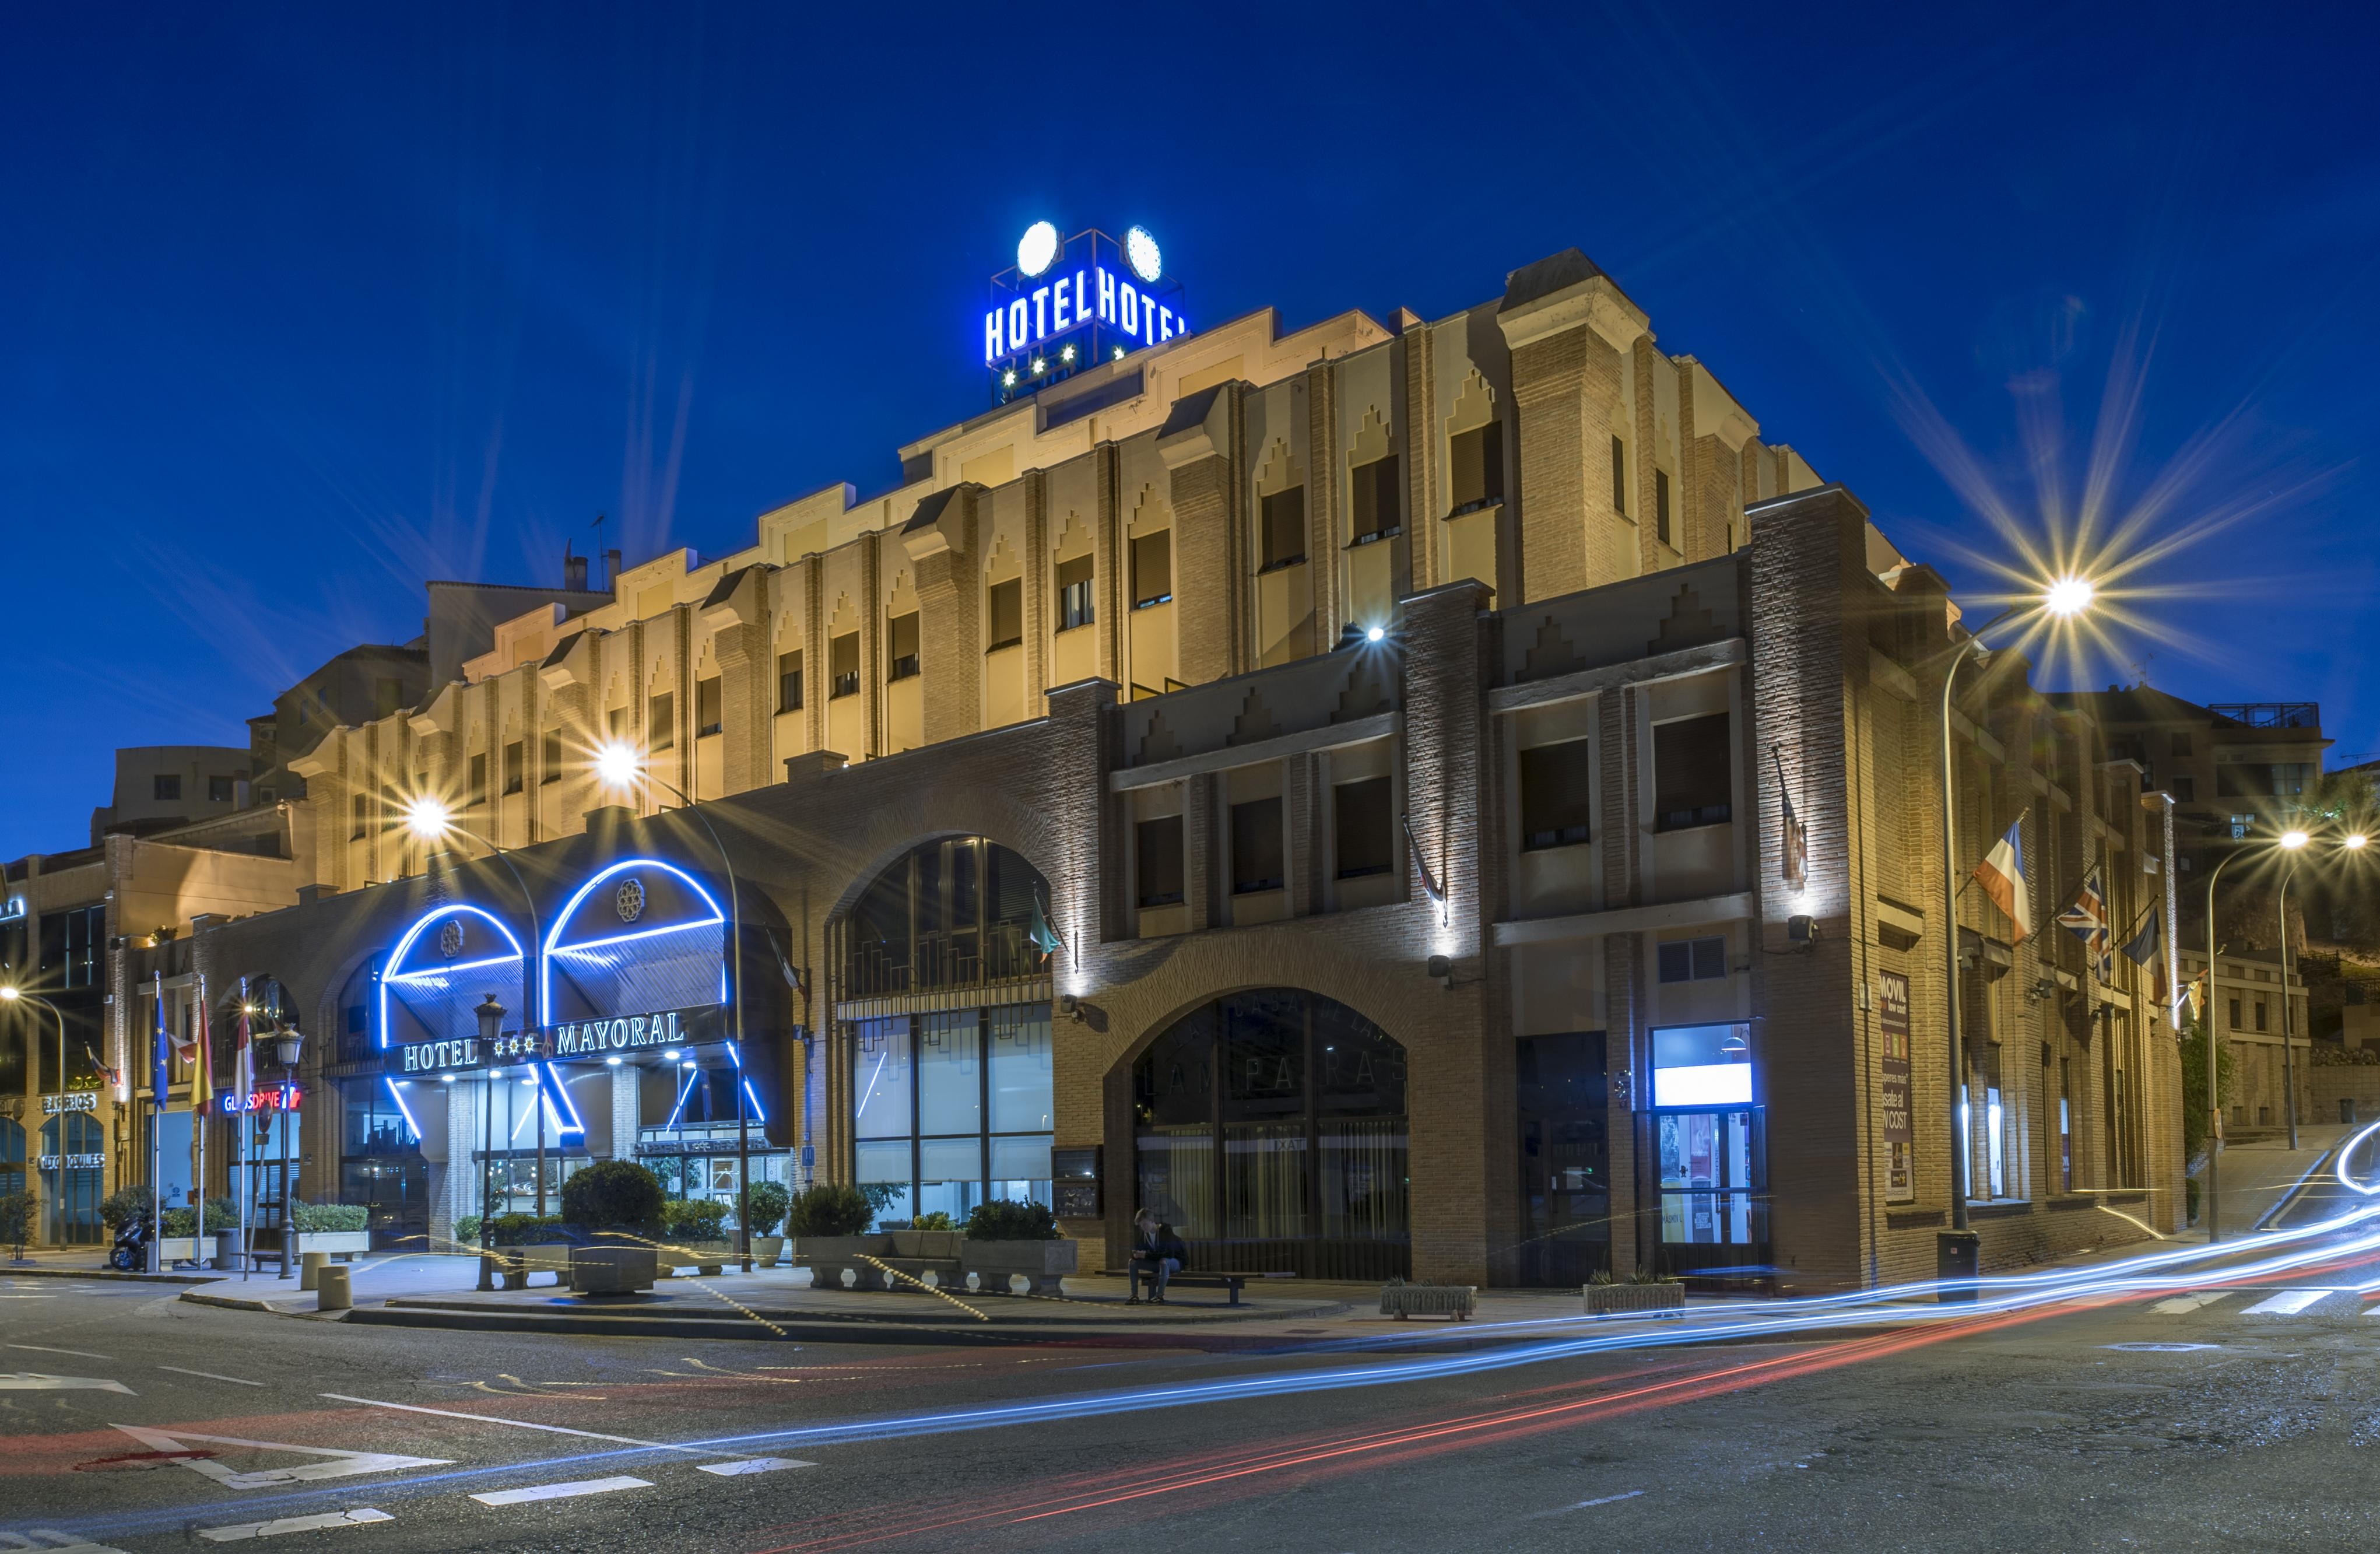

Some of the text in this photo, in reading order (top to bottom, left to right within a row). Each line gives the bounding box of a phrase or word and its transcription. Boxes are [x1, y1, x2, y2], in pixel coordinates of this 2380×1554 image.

[985, 269, 1093, 362] HOTEL
[1232, 992, 1298, 1018] CASA
[1320, 998, 1340, 1022] DE
[404, 1012, 684, 1072] HOTEL MAYORAL
[1898, 1090, 1903, 1107] al
[1889, 1110, 1907, 1129] COST
